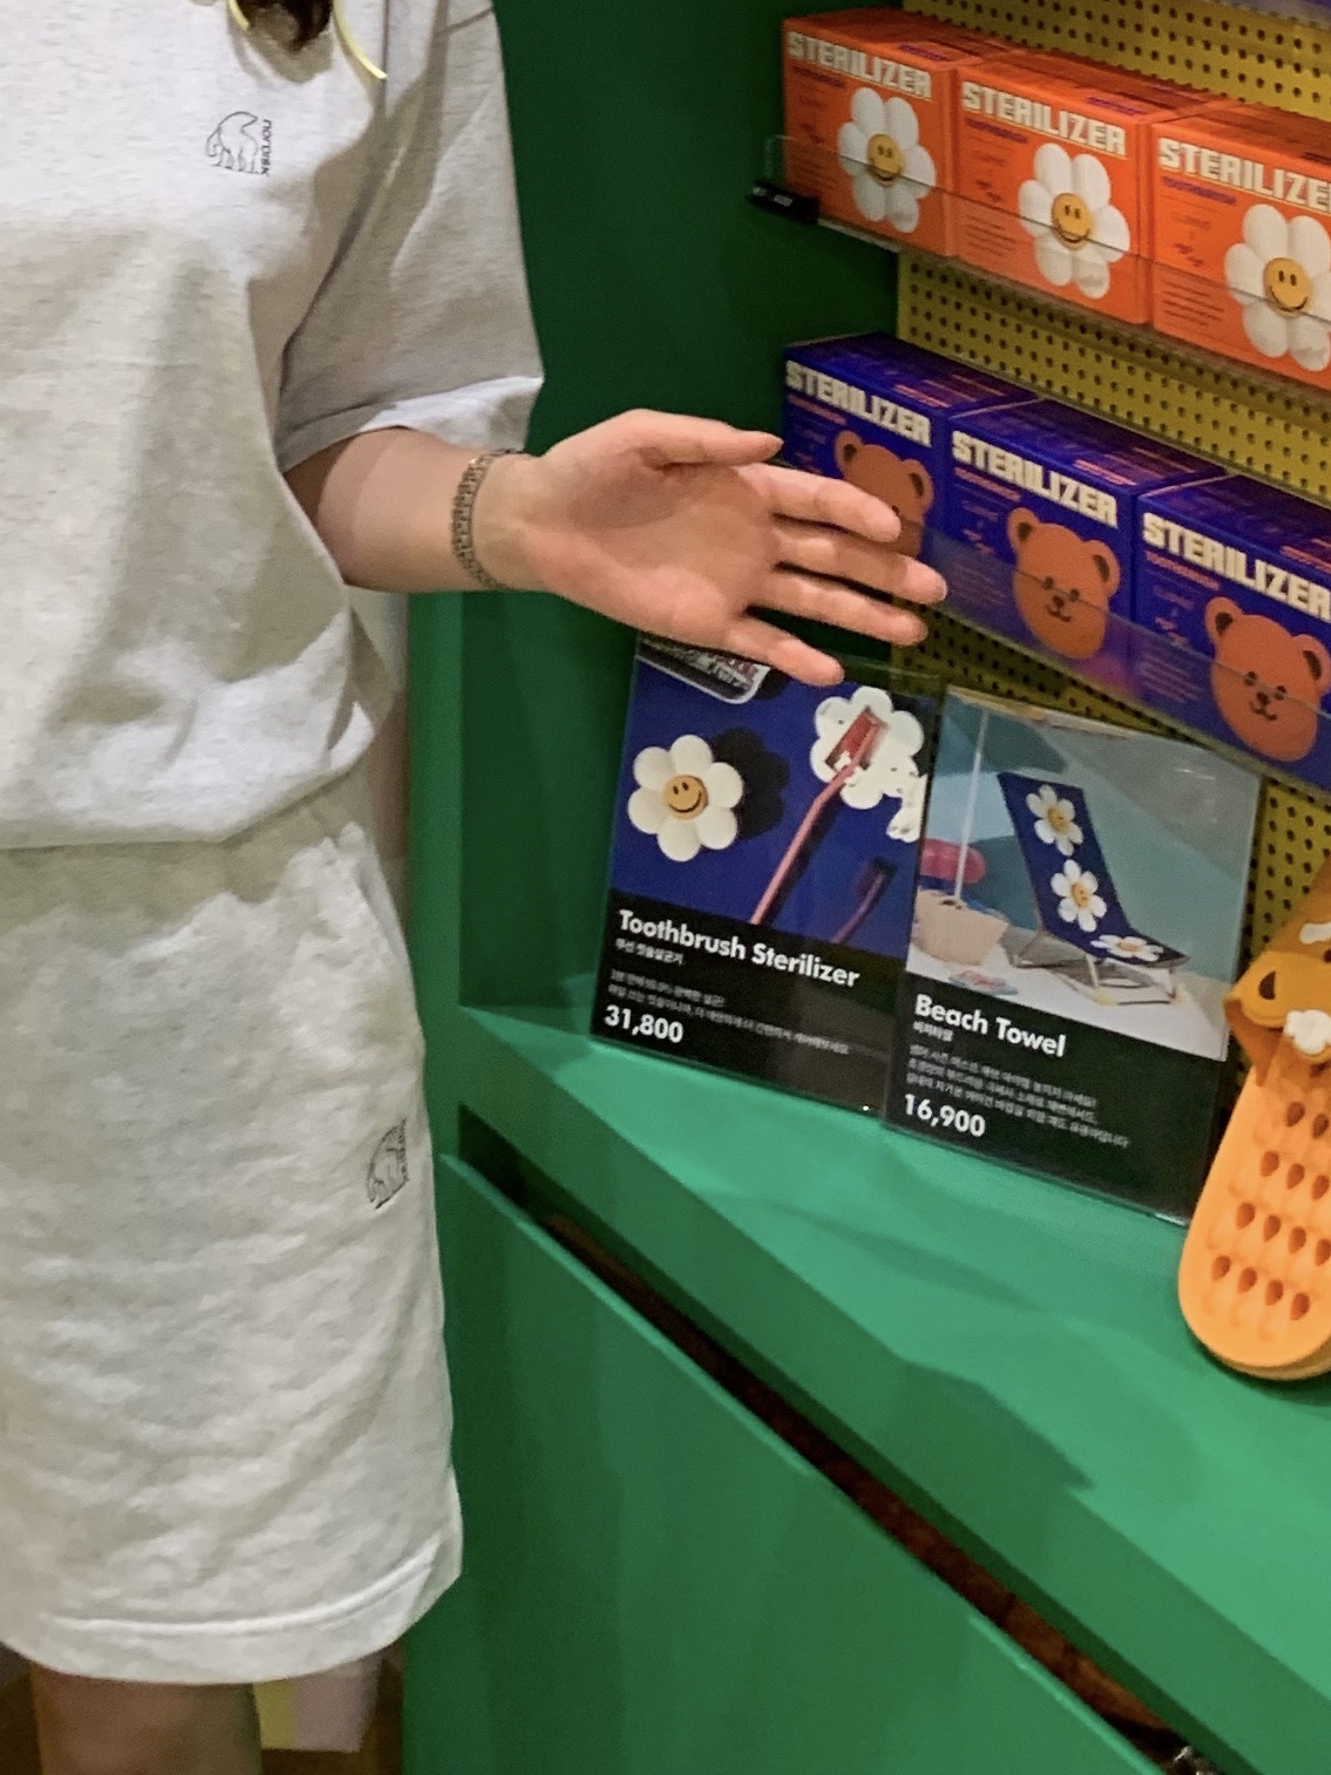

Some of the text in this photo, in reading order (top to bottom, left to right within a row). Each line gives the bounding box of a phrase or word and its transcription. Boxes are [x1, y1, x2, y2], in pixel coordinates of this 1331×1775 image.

[788, 31, 932, 102] STERILIZER
[962, 81, 1128, 159] STERILIZER
[786, 359, 932, 448] STERILIZER
[952, 430, 1118, 529] STERILIZER
[1143, 512, 1331, 624] STERILIZER
[619, 909, 860, 987] Toothbrush Sterilizer
[604, 1004, 684, 1044] 31,800
[915, 993, 1066, 1057] Beach Towel
[904, 1093, 986, 1137] 16,900
